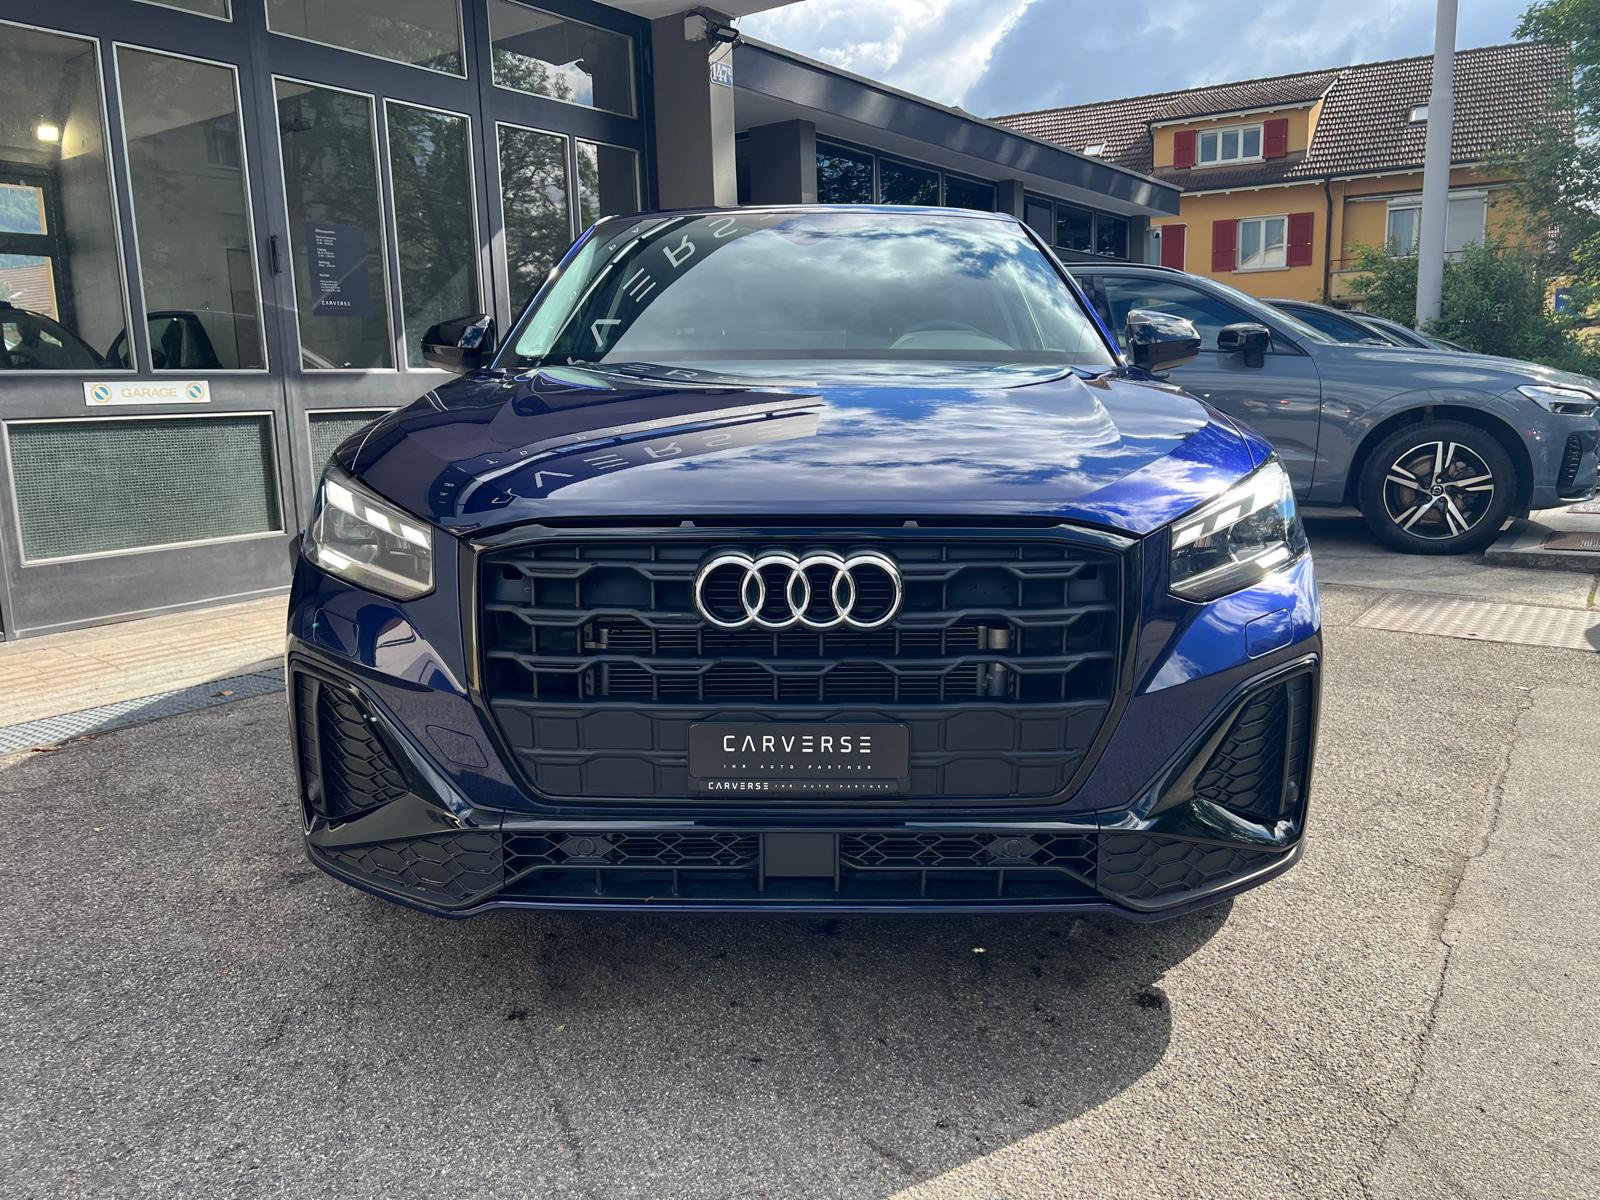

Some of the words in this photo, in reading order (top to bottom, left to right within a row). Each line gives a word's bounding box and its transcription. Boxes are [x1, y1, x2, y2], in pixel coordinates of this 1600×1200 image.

[121, 387, 178, 398] GARAGE
[723, 735, 871, 753] CARVERSE
[708, 782, 769, 790] CARVERSE
